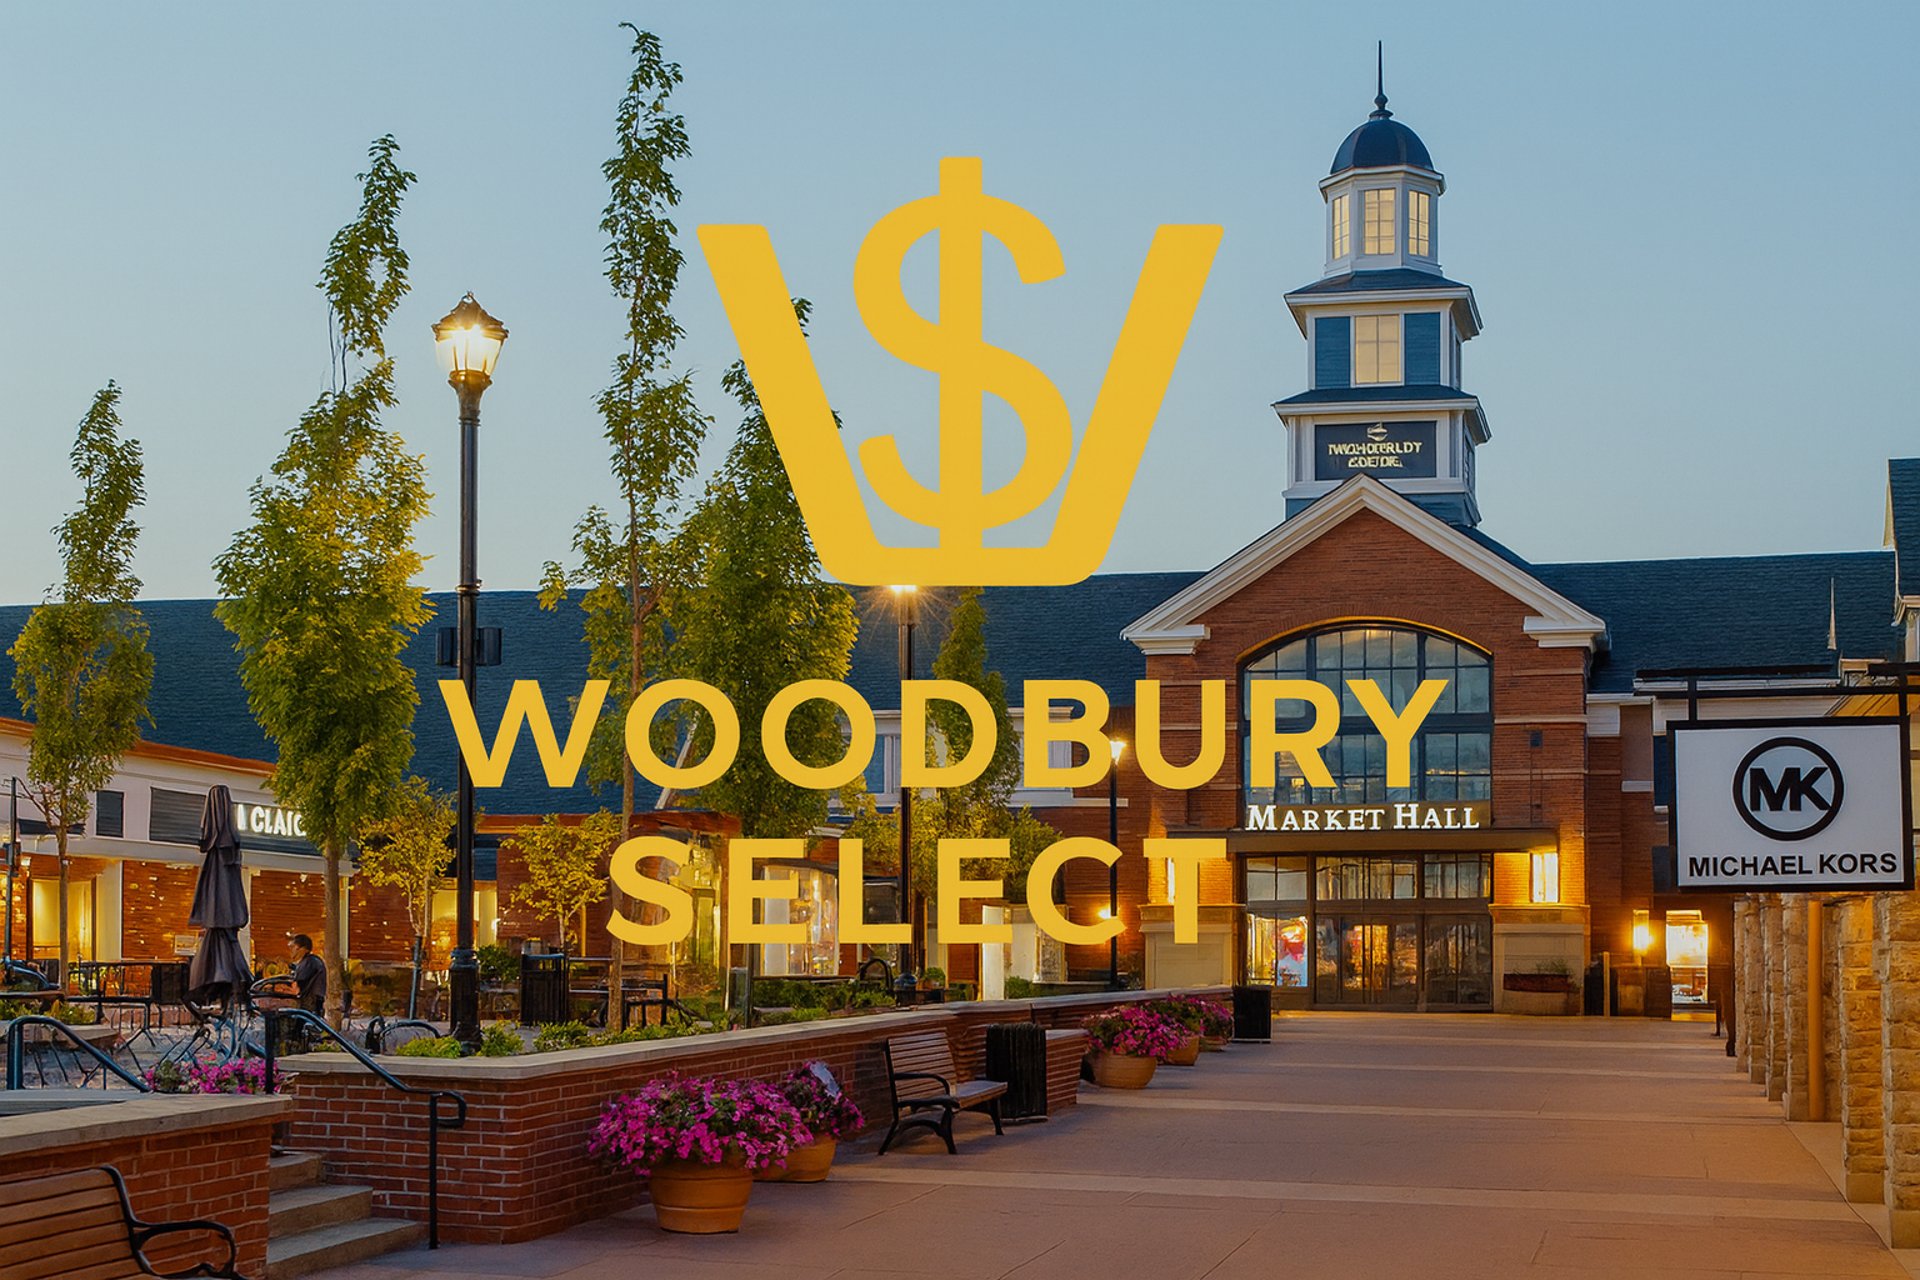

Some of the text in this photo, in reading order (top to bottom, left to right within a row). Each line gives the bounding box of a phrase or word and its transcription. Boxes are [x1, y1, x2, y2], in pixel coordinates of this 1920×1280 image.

[1246, 803, 1480, 831] MARKET HALL
[1688, 853, 1897, 877] MICHAEL KORS
